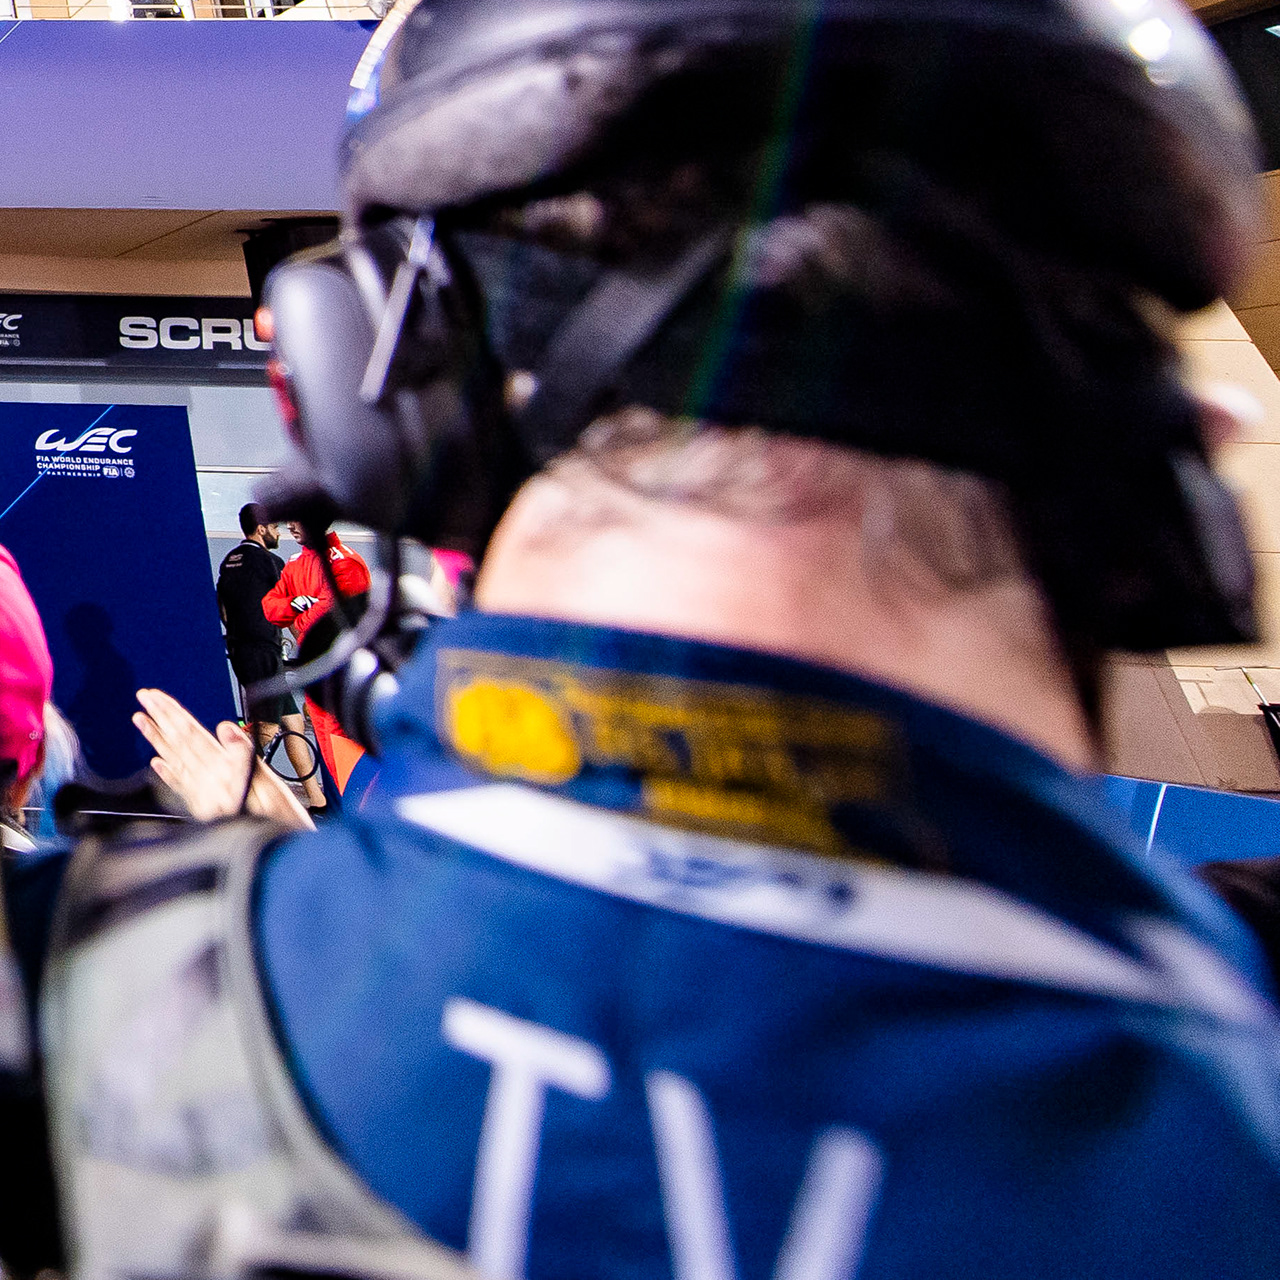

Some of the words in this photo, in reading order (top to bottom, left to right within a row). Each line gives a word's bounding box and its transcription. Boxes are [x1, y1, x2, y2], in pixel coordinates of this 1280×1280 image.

[35, 427, 138, 454] WEC
[51, 456, 82, 464] WORLD
[83, 457, 134, 466] ENDURANCE
[36, 462, 101, 471] CHAMPIONSHIP
[102, 466, 119, 477] FIA
